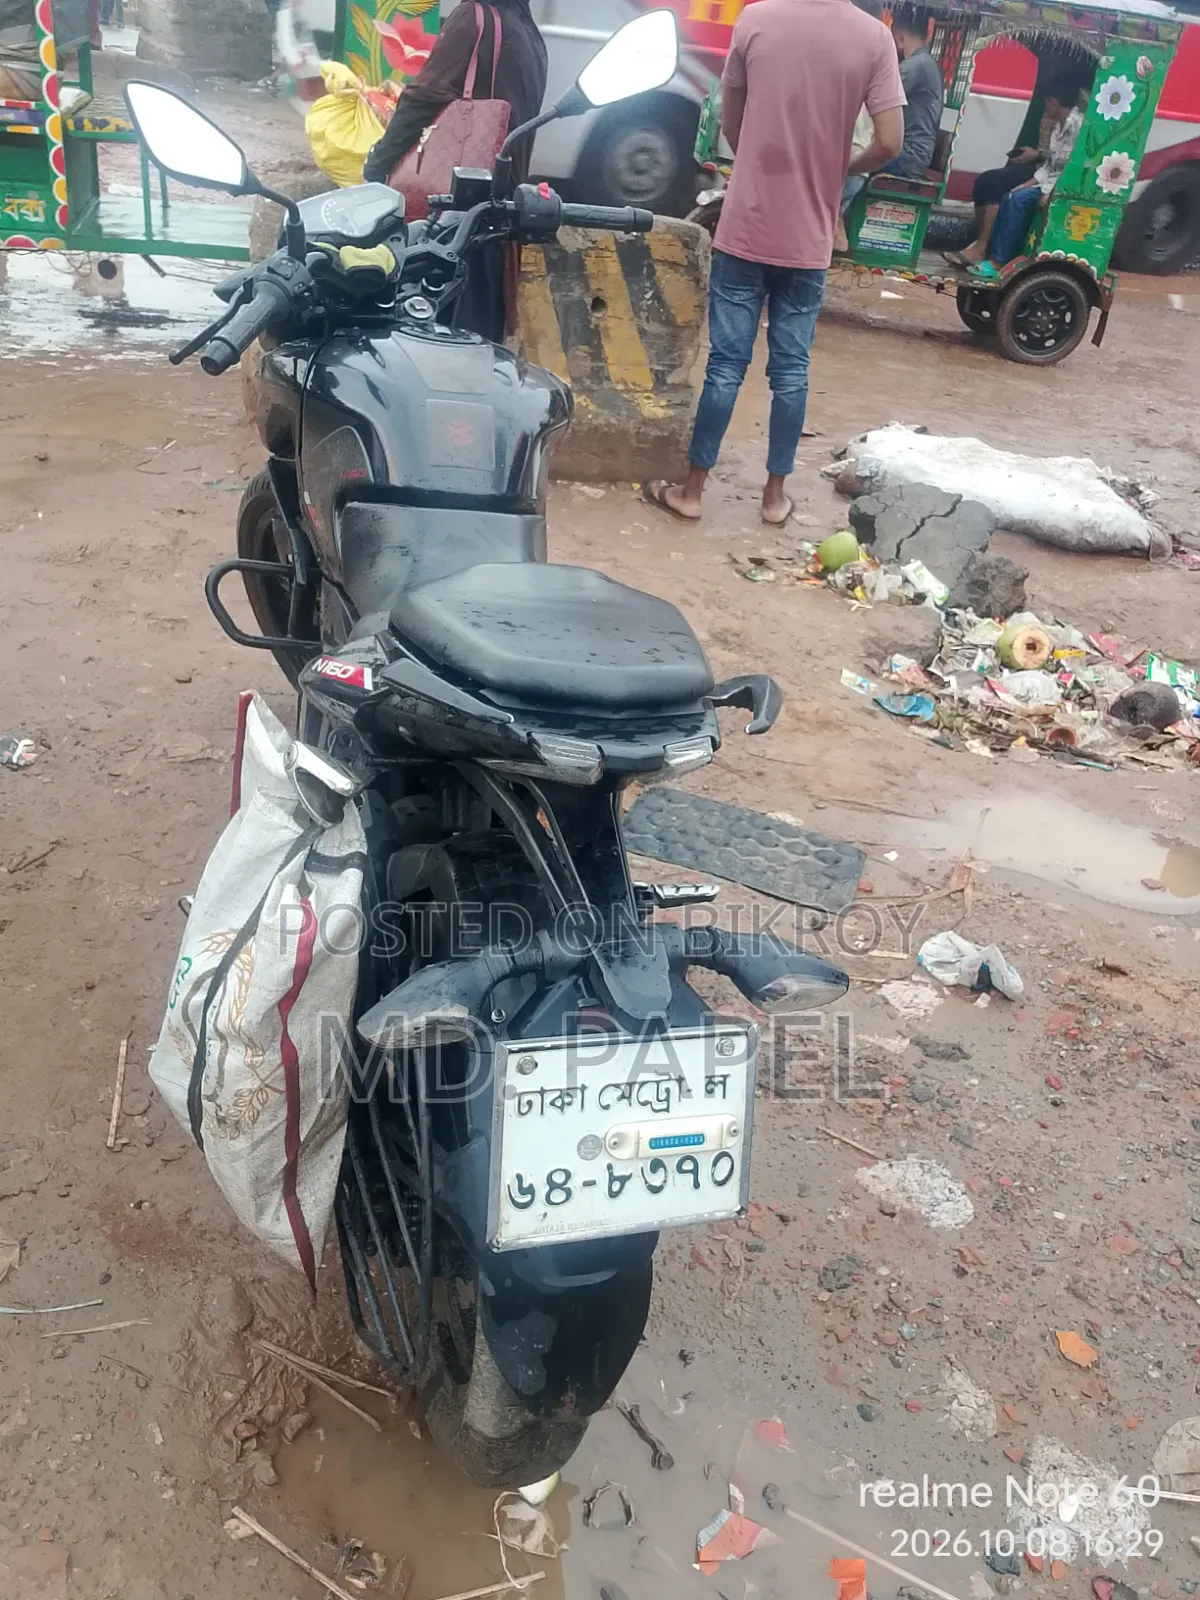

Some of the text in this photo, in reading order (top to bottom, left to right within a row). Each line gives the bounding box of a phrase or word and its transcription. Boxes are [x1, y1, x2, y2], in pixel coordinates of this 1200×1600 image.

[311, 658, 356, 679] N160
[515, 1083, 588, 1116] ঢাকা
[507, 1150, 735, 1210] ৬৪-৮৩৭০
